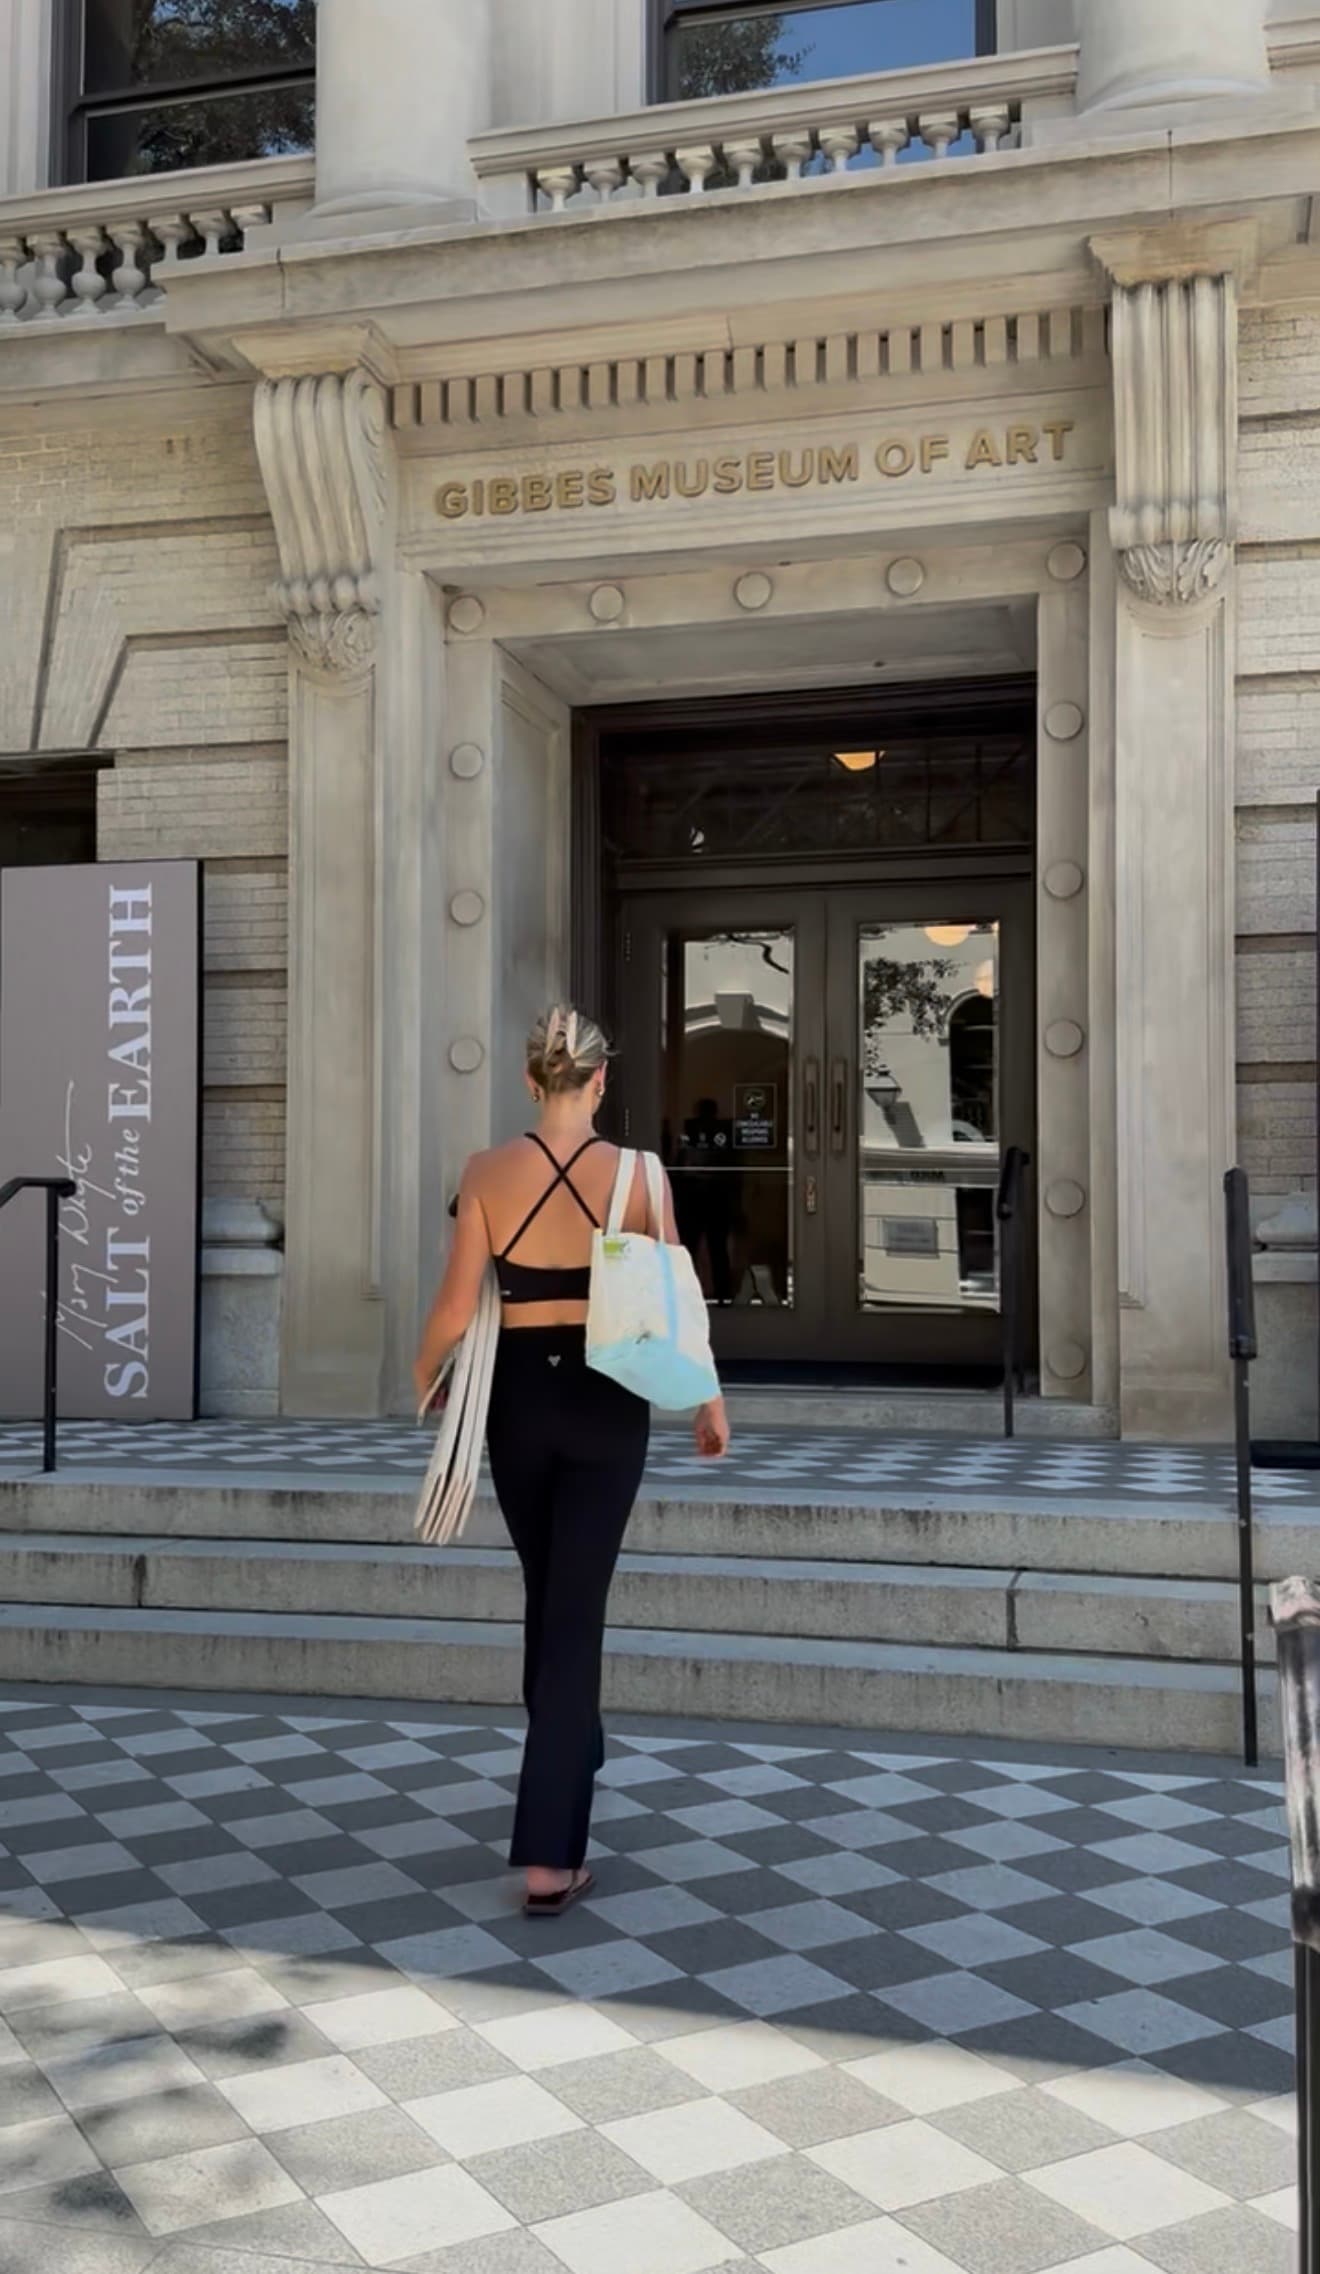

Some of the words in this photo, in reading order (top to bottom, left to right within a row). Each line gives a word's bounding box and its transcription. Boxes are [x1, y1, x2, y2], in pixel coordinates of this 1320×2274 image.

[436, 471, 616, 519] GIBBES
[630, 445, 858, 502] MUSEUM
[876, 436, 950, 477] OF
[965, 421, 1074, 470] ART
[108, 882, 152, 1122] EARTH
[113, 1178, 145, 1216] of
[114, 1128, 140, 1177] the
[104, 1227, 149, 1399] SALT
